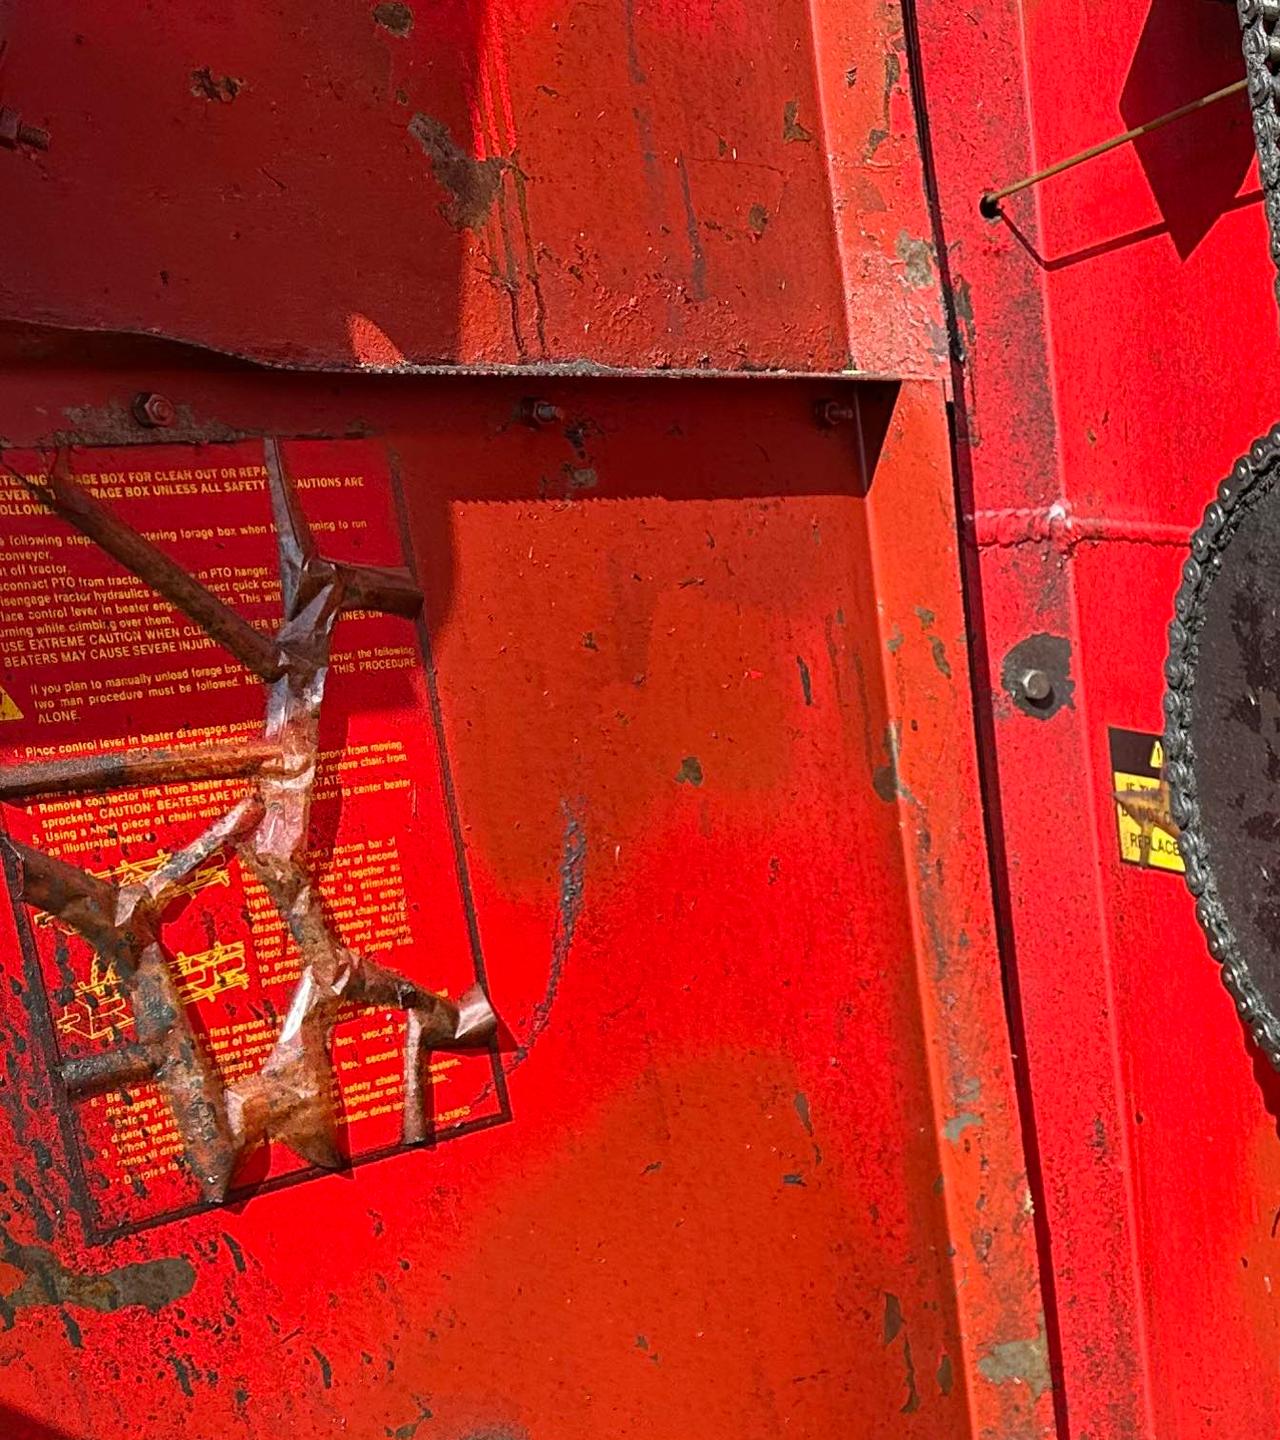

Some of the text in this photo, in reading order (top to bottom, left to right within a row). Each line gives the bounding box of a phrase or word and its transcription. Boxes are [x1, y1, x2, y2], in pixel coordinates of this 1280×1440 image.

[100, 466, 268, 484] BOX FOR CLEAN OUT OR REPA
[0, 476, 364, 501] EVER BOX UNLESS ALL SAFETY ARE
[0, 504, 54, 515] OLLOWE
[10, 535, 62, 547] following
[180, 529, 214, 541] forage
[217, 526, 237, 537] box
[240, 524, 267, 536] when
[338, 520, 348, 530] to
[352, 520, 367, 529] run
[51, 576, 76, 588] PTO
[78, 576, 105, 587] from
[210, 567, 232, 578] PTO
[53, 593, 91, 604] tractor
[93, 589, 150, 602] hydraulics
[232, 581, 260, 593] quick
[28, 607, 68, 619] control
[71, 606, 98, 617] lever
[101, 605, 113, 615] in
[115, 602, 149, 614] beater
[239, 593, 261, 605] This
[36, 623, 65, 634] while
[119, 619, 141, 629] over
[144, 616, 175, 626] them.
[0, 642, 24, 653] USE
[29, 637, 86, 651] EXTREME
[89, 632, 141, 645] CAUTION
[145, 628, 180, 640] WHEN
[4, 652, 58, 668] BEATERS
[61, 649, 86, 662] MAY
[89, 645, 131, 660] CAUSE
[132, 641, 177, 656] SEVERE
[30, 684, 38, 695] If
[41, 683, 61, 696] you
[64, 680, 88, 693] plan
[91, 680, 102, 690] to
[105, 674, 152, 688] manually
[155, 670, 189, 683] unload
[191, 666, 222, 680] forage
[224, 663, 243, 675] box
[357, 649, 372, 659] the
[374, 646, 415, 660] following
[34, 699, 55, 710] two
[60, 697, 84, 707] man
[88, 690, 143, 706] procedure
[148, 686, 175, 697] must
[179, 684, 192, 695] be
[333, 663, 355, 675] THIS
[358, 658, 417, 671] PROCEDURE
[58, 739, 97, 755] control
[99, 736, 126, 749] lever
[127, 735, 140, 748] in
[140, 730, 175, 745] beater
[176, 723, 228, 742] disengage
[347, 745, 369, 757] from
[38, 800, 82, 815] Remove
[85, 793, 139, 809] connector
[142, 788, 162, 800] link
[164, 784, 189, 797] from
[386, 753, 407, 764] from
[41, 812, 97, 830] sprockets.
[156, 795, 207, 812] BEATERS
[209, 791, 231, 804] ARE
[45, 828, 77, 844] Using
[121, 817, 151, 831] piece
[154, 815, 165, 826] of
[199, 807, 222, 819] with
[341, 787, 351, 797] to
[353, 784, 382, 797] center
[384, 779, 412, 792] beater
[63, 839, 117, 855] illustrated
[367, 850, 399, 862] second
[347, 865, 386, 881] together
[360, 876, 402, 890] eliminate
[210, 1025, 231, 1038] first
[232, 1019, 265, 1034] person
